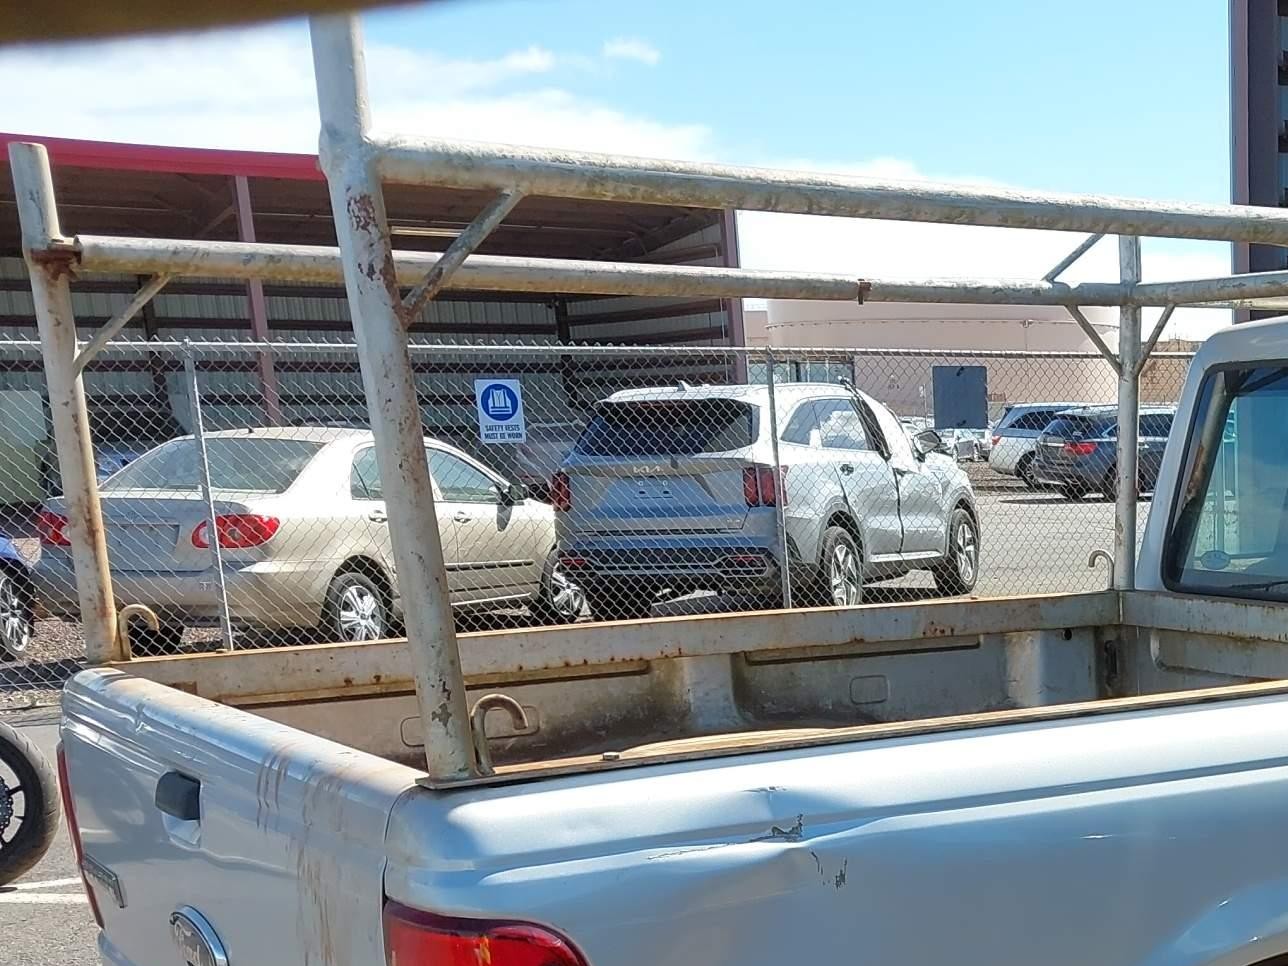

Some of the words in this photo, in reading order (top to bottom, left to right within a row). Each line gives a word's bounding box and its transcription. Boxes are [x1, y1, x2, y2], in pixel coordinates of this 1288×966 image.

[484, 424, 504, 432] SAFETY
[504, 424, 520, 432] VESTS
[499, 432, 506, 440] BE
[507, 432, 523, 440] WORN
